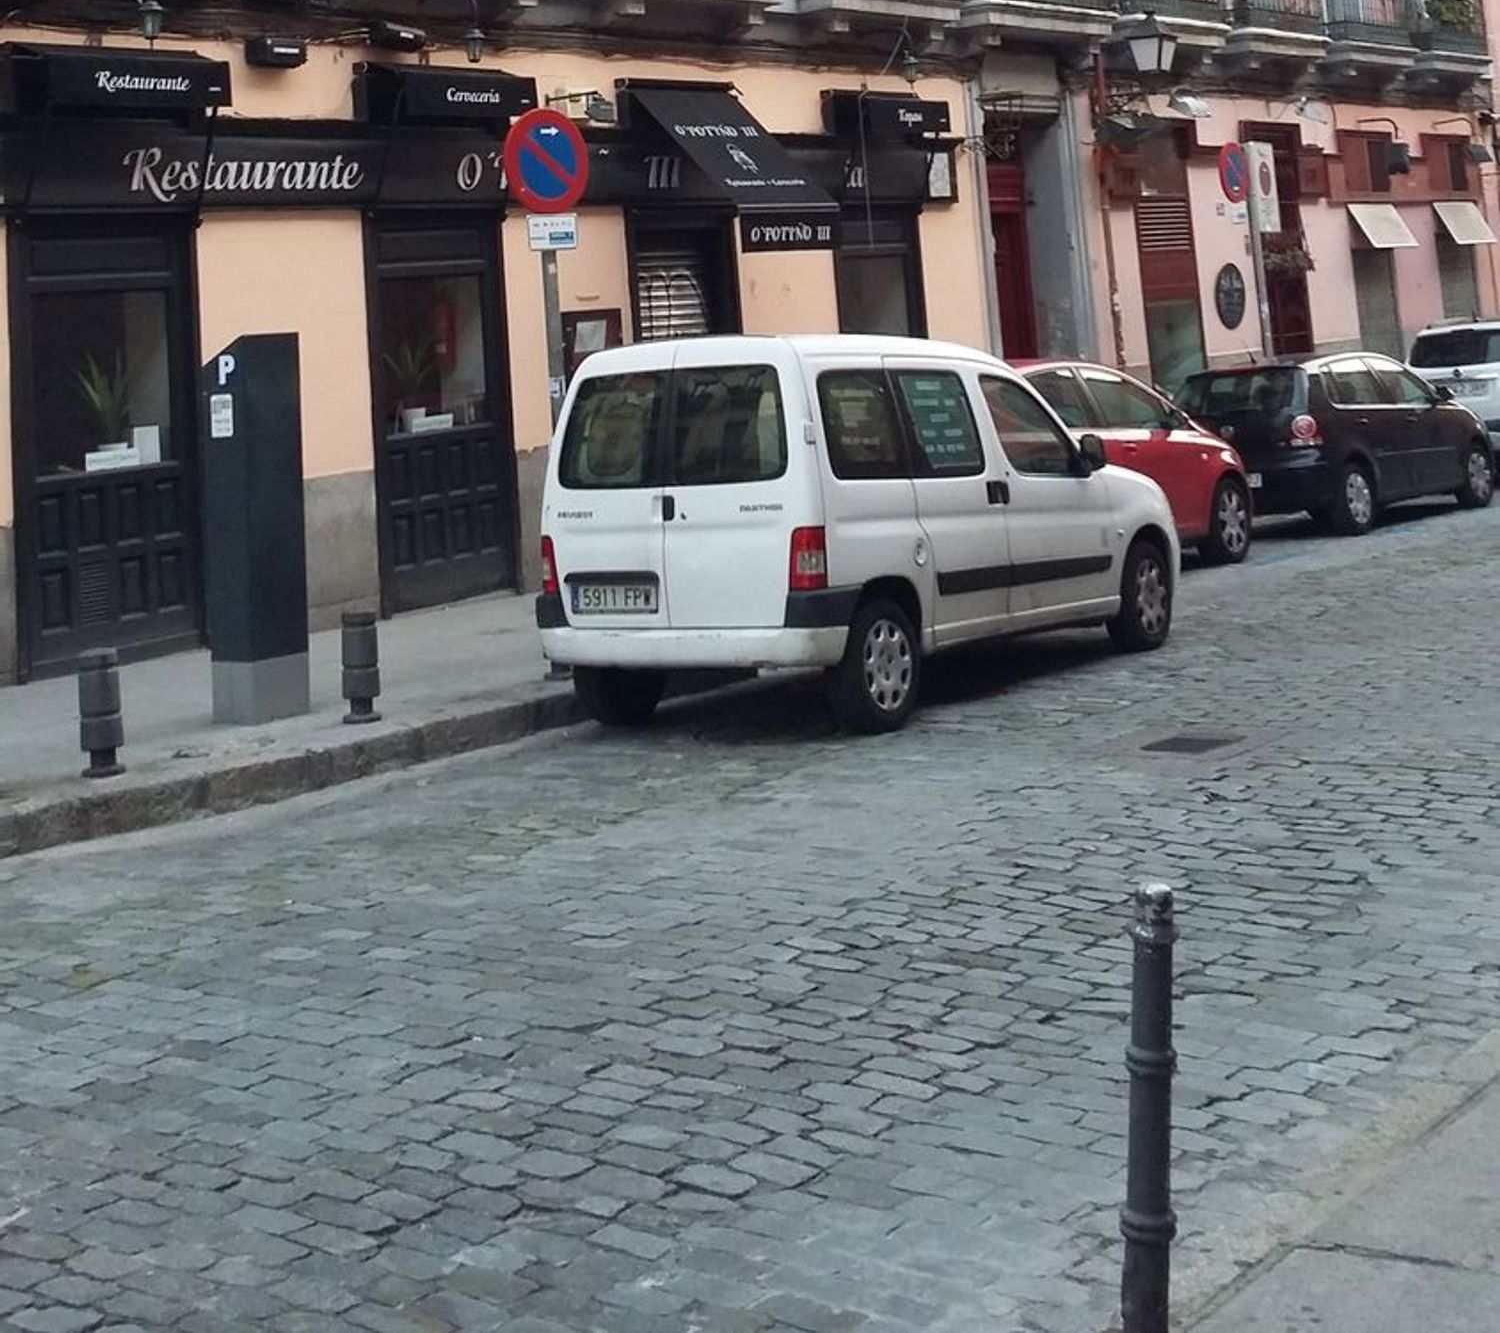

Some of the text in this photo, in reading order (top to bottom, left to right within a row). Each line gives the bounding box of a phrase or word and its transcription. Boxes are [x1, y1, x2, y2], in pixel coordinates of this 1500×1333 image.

[94, 70, 191, 93] Restaurante
[122, 147, 364, 202] Restaurante
[816, 225, 831, 241] III
[218, 354, 235, 385] P
[583, 587, 652, 607] 5911 FPW
